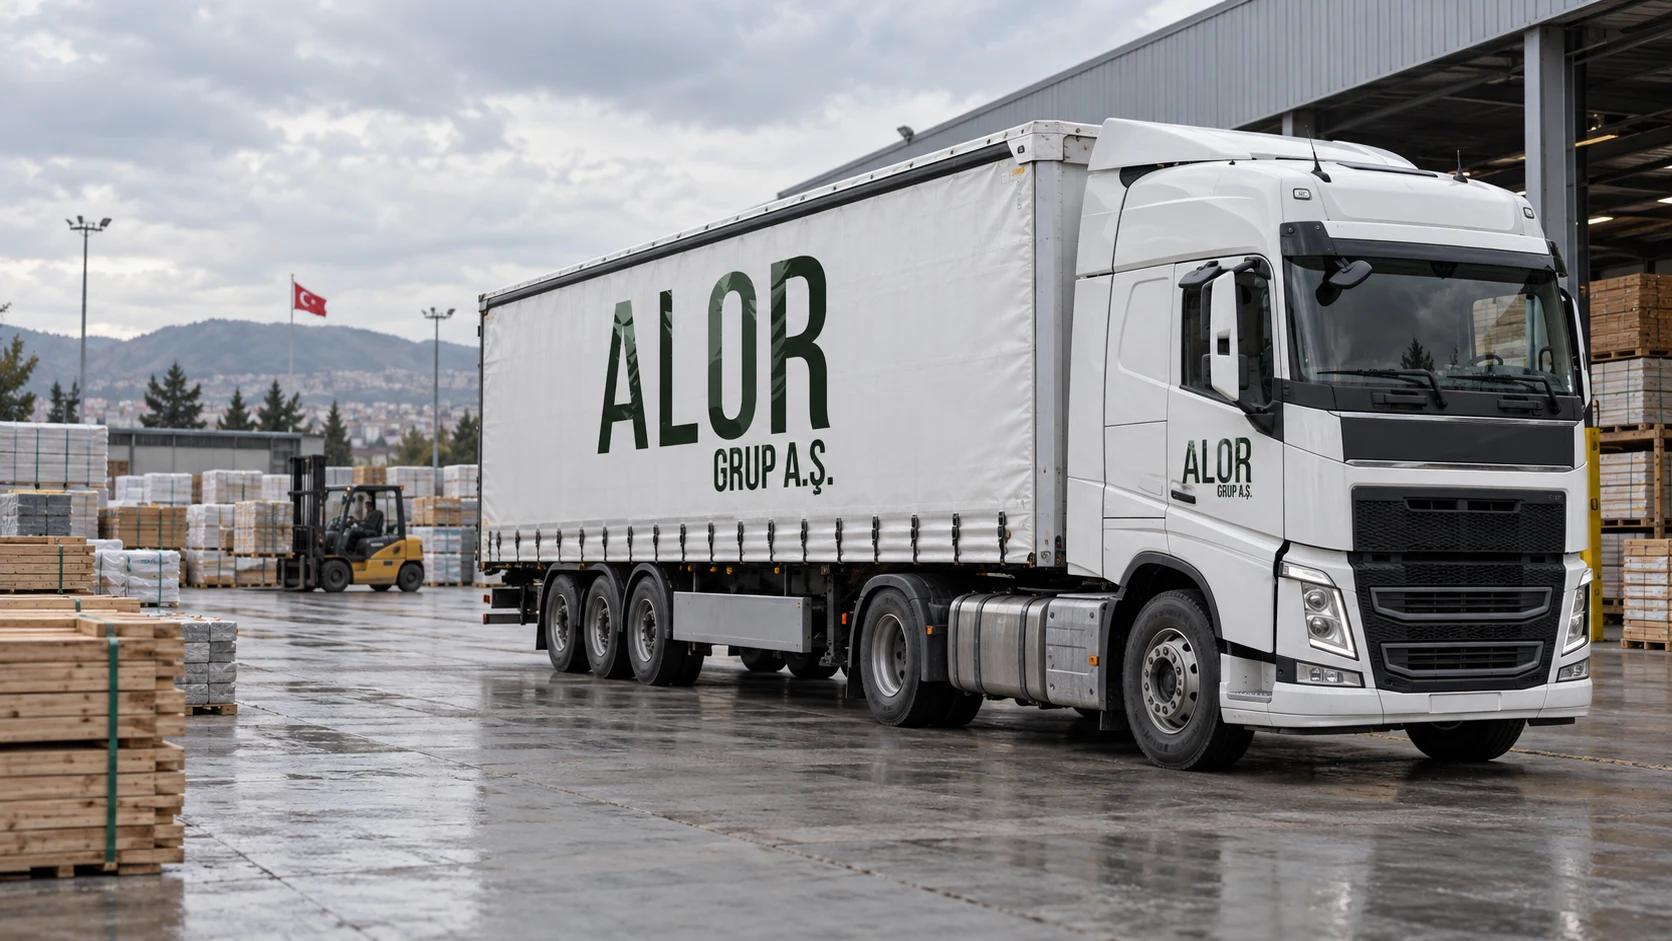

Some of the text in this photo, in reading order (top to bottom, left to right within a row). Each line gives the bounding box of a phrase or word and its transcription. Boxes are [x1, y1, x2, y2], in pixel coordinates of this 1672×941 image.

[597, 255, 831, 454] ALOR
[713, 438, 834, 496] GRUP A.Ş.
[1182, 437, 1252, 484] ALOR
[1217, 484, 1253, 500] GRUP A.Ş.
